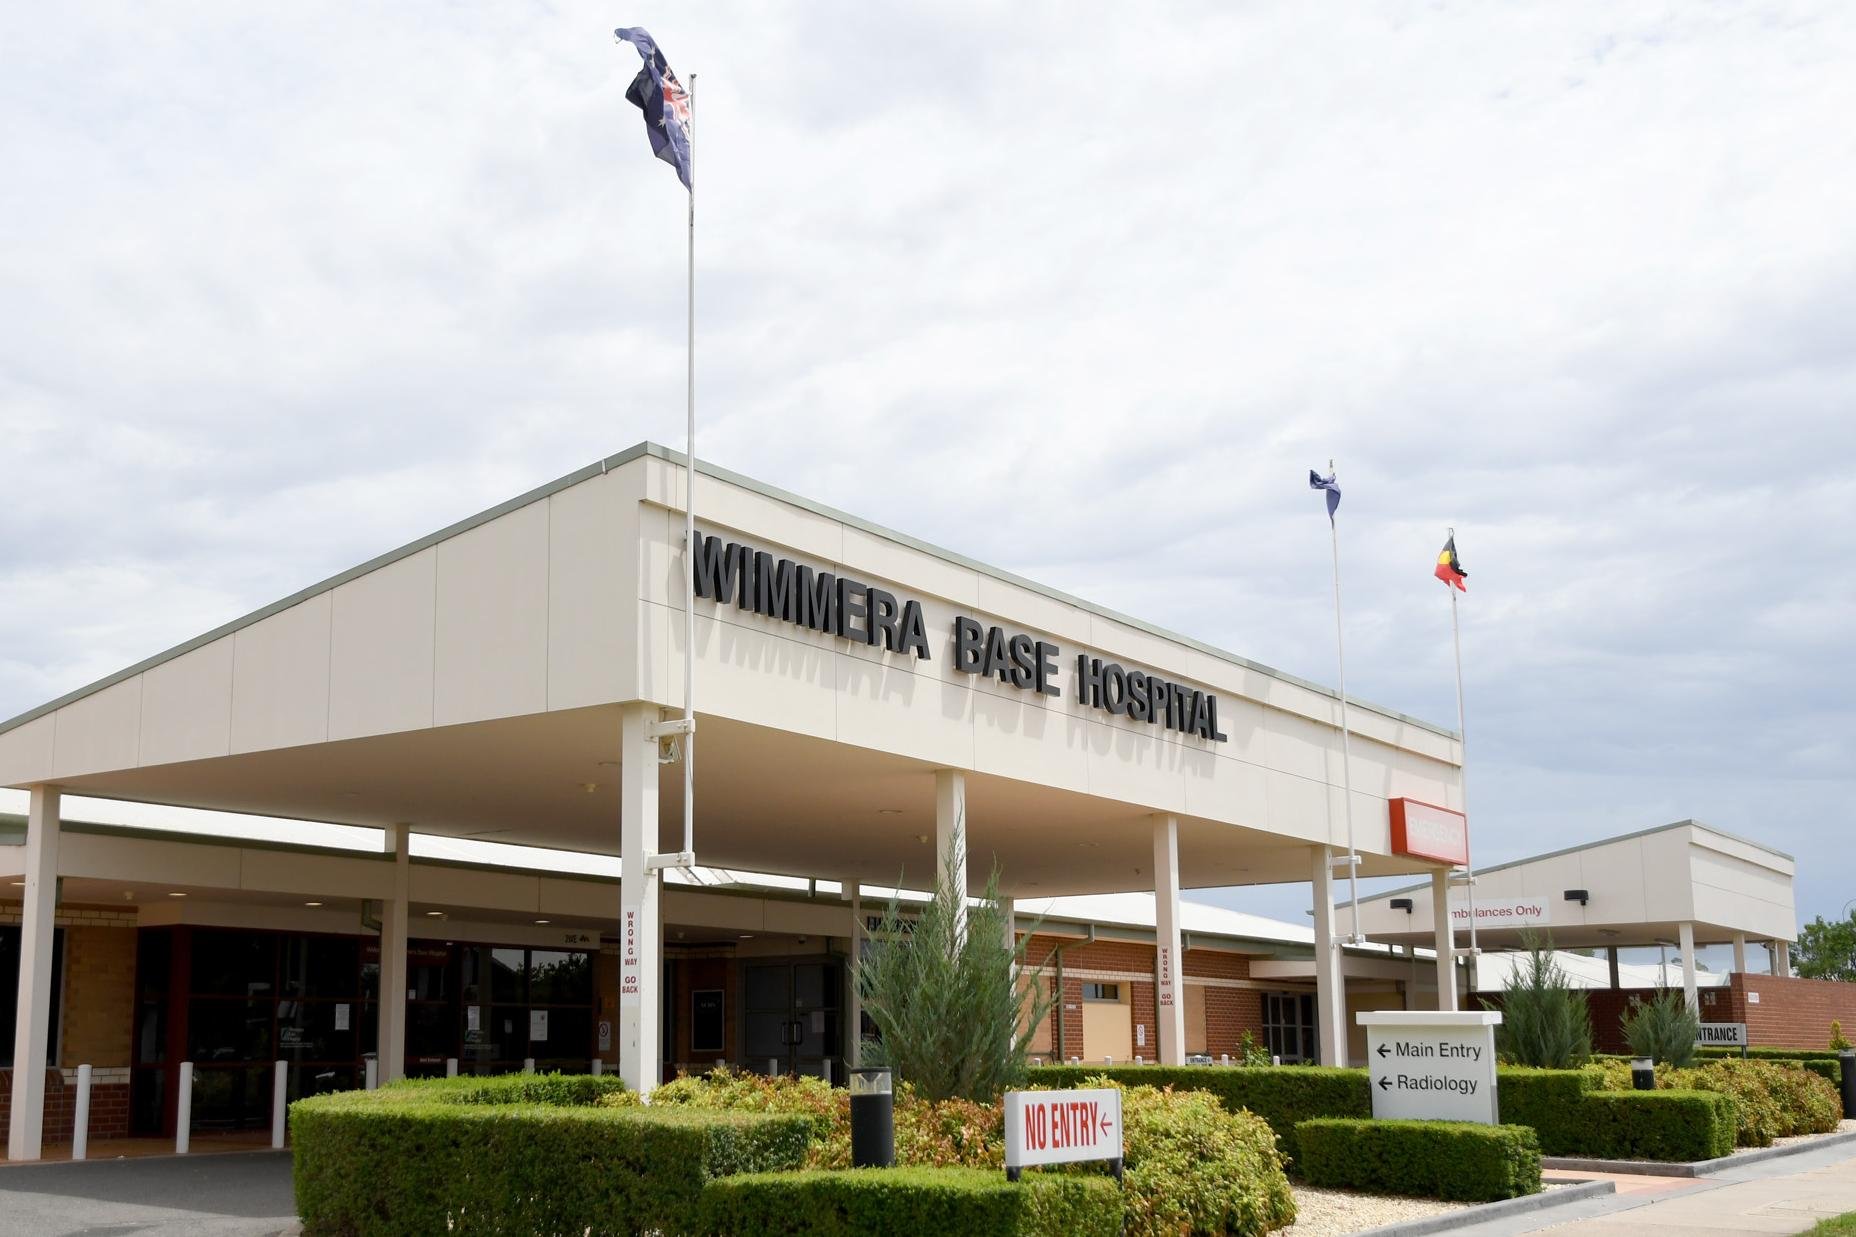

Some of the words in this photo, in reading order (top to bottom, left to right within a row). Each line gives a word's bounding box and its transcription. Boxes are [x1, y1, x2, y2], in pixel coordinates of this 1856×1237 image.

[687, 530, 930, 660] WIMMERA
[955, 616, 1060, 697] BASE
[1077, 654, 1227, 742] HOSPITAL
[1451, 907, 1512, 918] mblances
[1515, 904, 1541, 917] Only
[626, 911, 635, 955] WRONG
[624, 958, 637, 966] WAY
[625, 976, 636, 984] GO
[622, 985, 638, 994] BACK
[1695, 1026, 1738, 1041] NTRANCE
[1396, 1042, 1434, 1057] Main
[1439, 1042, 1482, 1061] Entry
[1397, 1074, 1478, 1095] Radiology
[1025, 1103, 1046, 1150] NO
[1051, 1101, 1098, 1148] ENTRY
